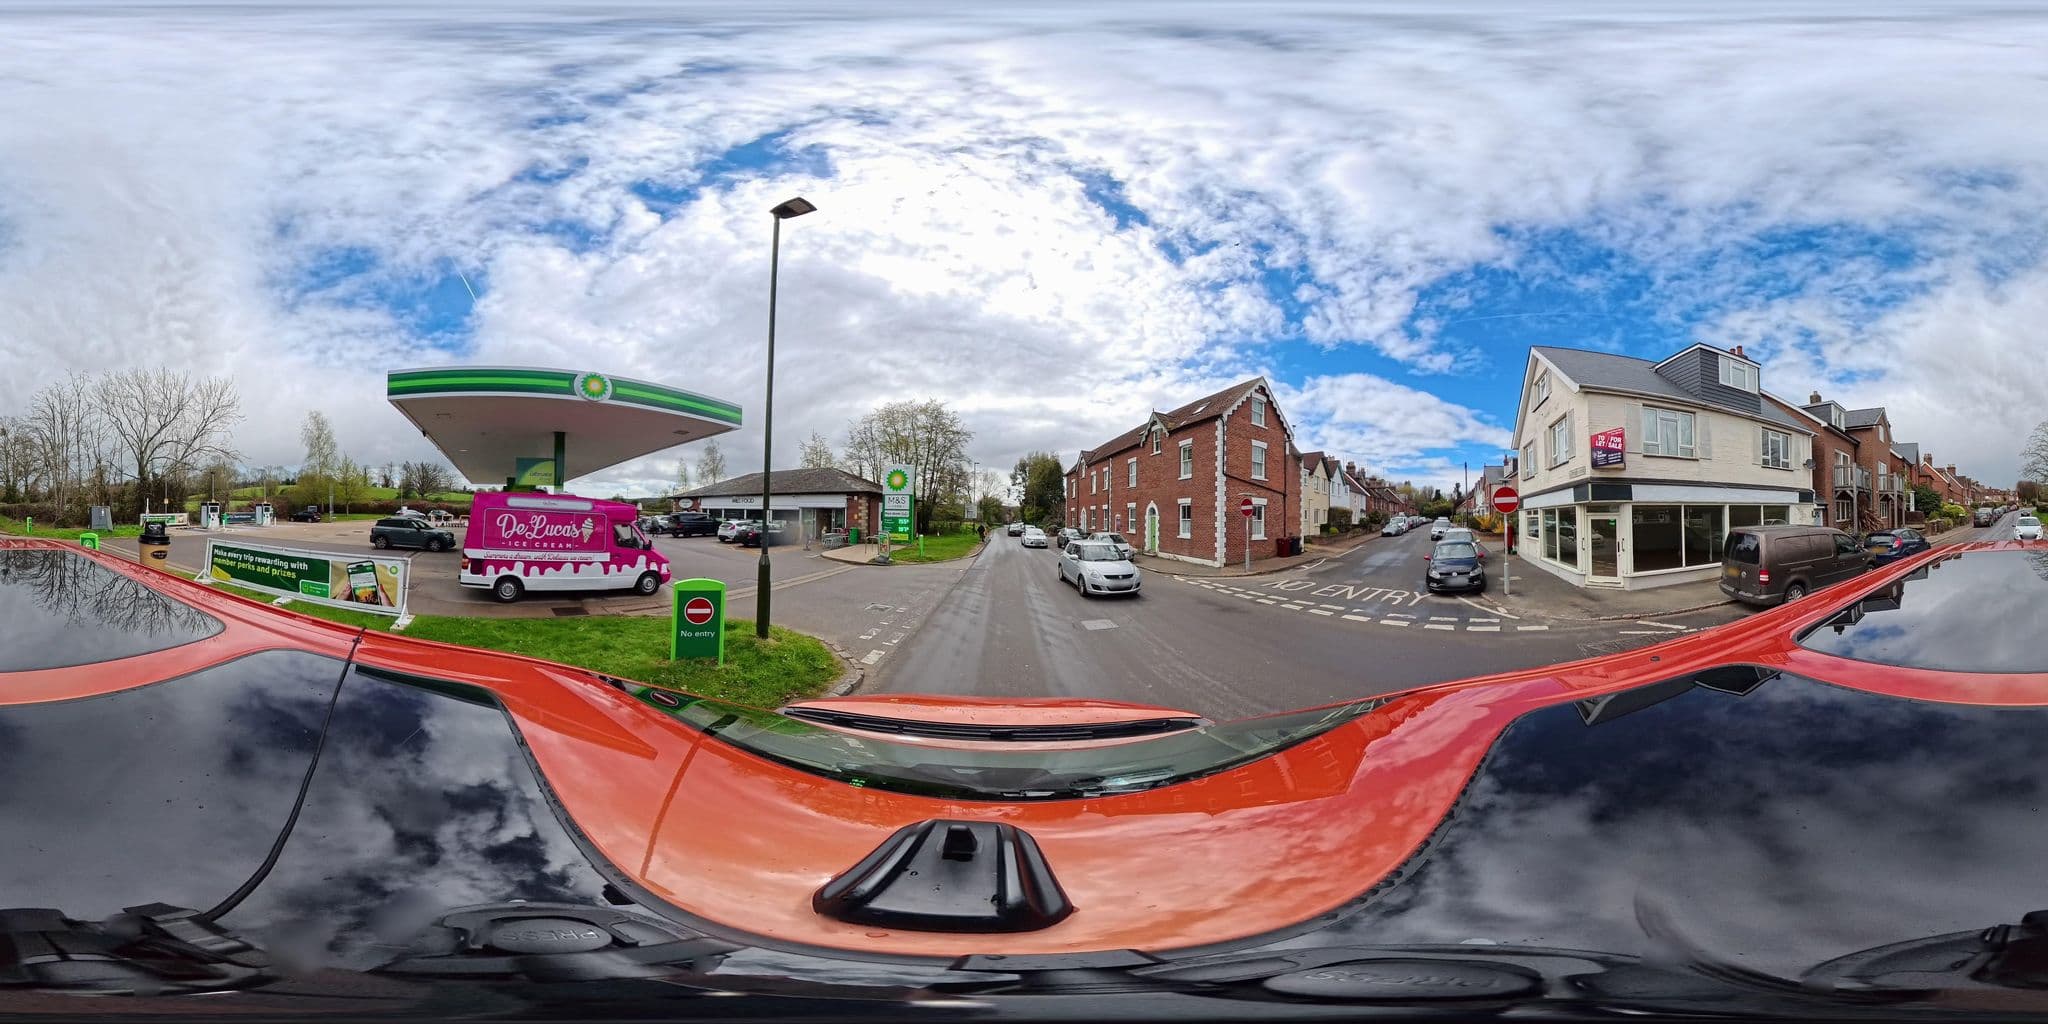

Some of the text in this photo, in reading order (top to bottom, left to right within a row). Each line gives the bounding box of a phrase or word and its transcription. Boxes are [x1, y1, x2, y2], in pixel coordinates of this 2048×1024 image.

[1608, 442, 1622, 450] SALE
[887, 496, 906, 505] M&S
[213, 548, 308, 571] Make every trip rewarding with
[213, 557, 297, 579] member perks and prizes
[1260, 579, 1433, 607] NO ENTRY
[694, 630, 716, 638] entry
